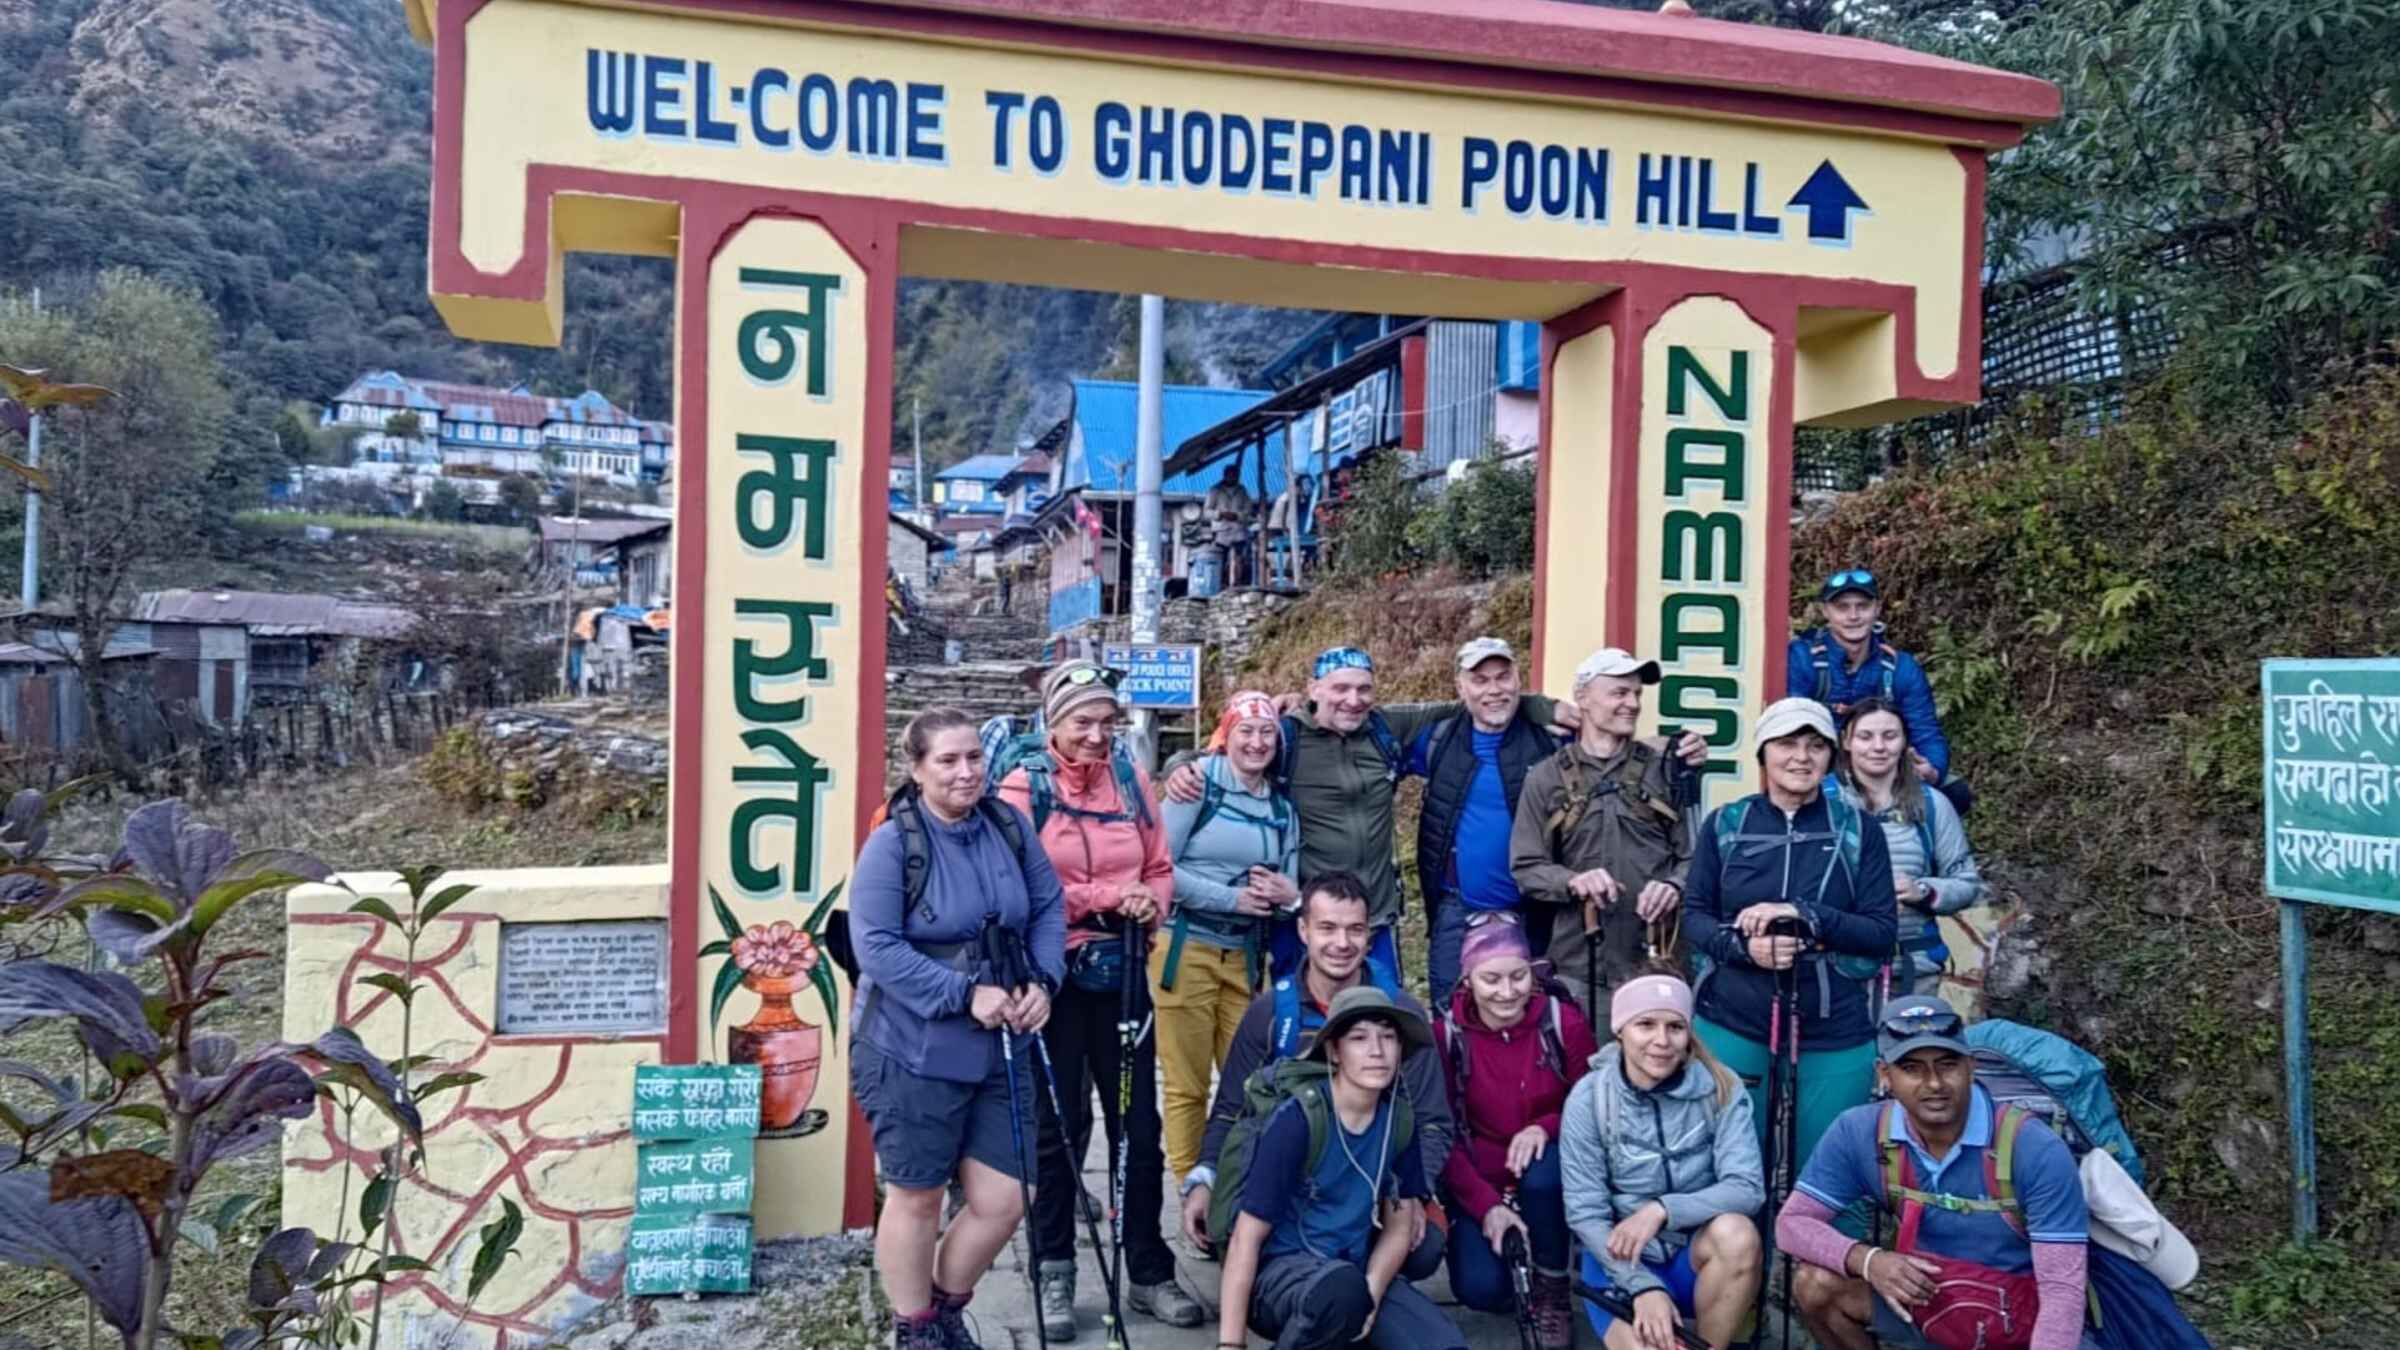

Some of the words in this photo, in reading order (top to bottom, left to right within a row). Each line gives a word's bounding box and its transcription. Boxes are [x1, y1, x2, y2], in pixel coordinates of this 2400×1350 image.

[986, 92, 1065, 173] TO
[1094, 103, 1430, 206] GHODEPANI
[1462, 138, 1610, 221] POON
[1637, 158, 1781, 235] HILL
[1659, 346, 1749, 775] NAMAS
